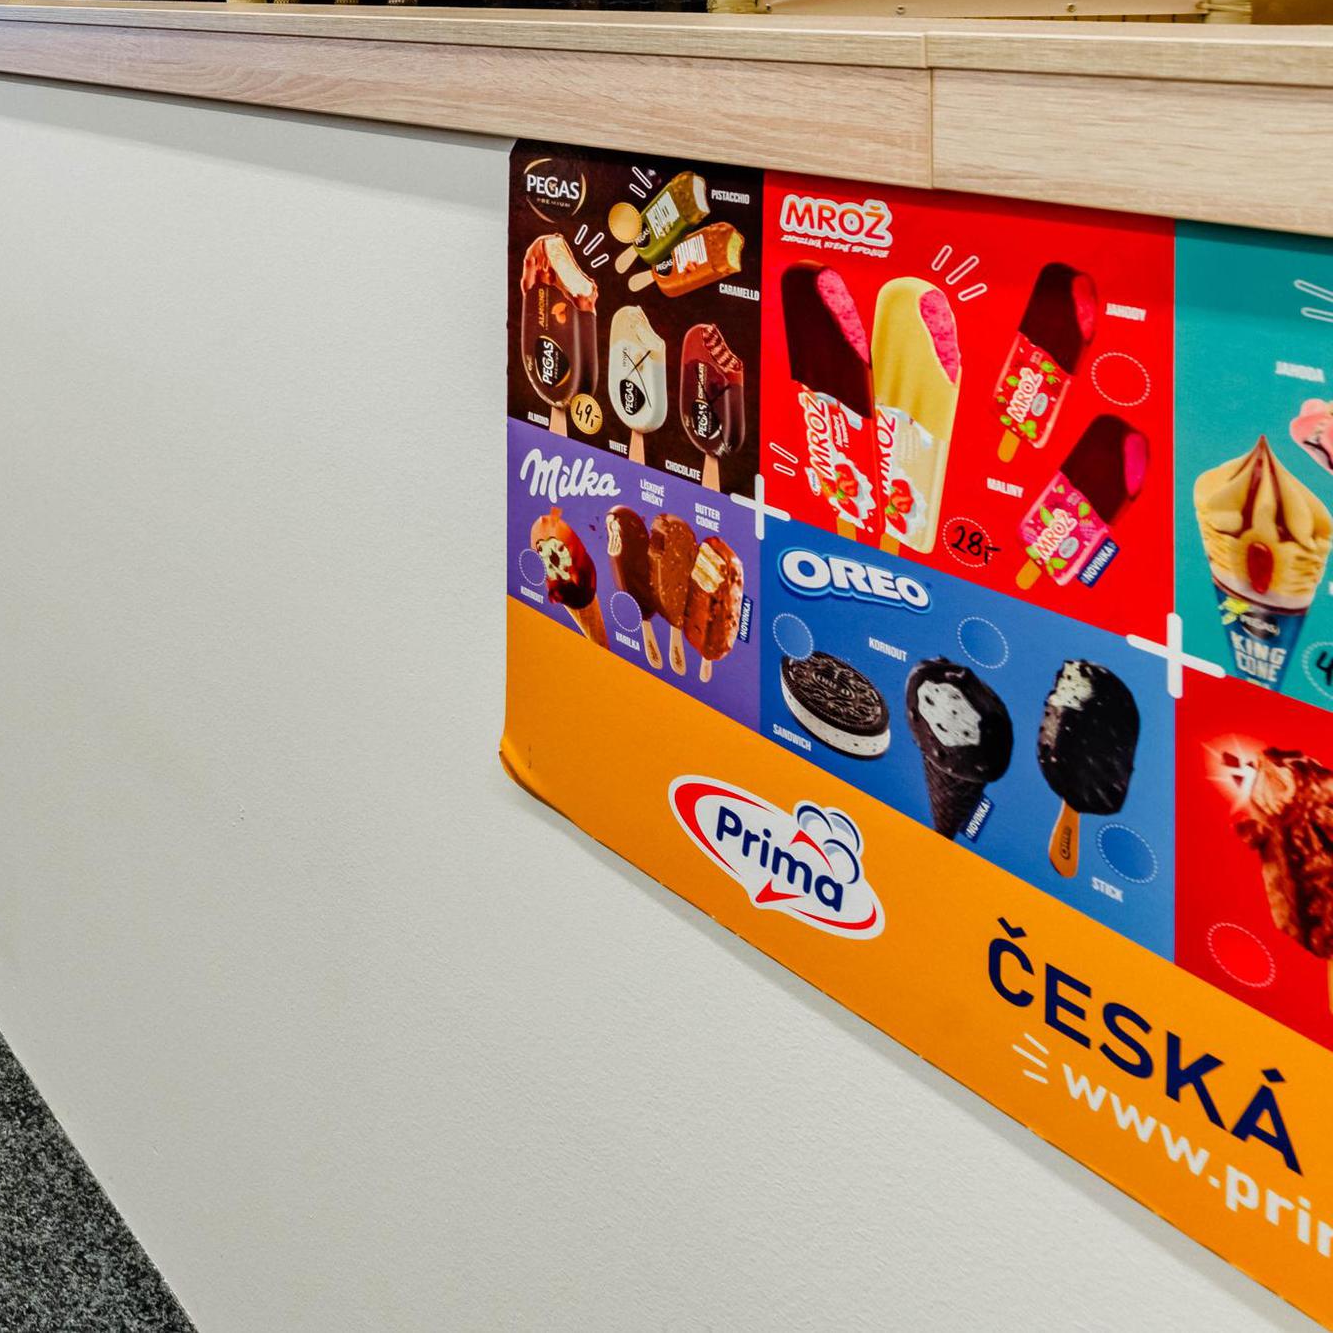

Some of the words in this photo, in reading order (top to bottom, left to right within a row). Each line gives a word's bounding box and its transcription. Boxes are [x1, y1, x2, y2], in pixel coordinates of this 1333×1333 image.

[526, 174, 580, 200] PEGAS
[711, 188, 751, 205] PISTACCHIO
[781, 195, 891, 245] MROŽ
[718, 283, 760, 302] CARAMELLO
[542, 340, 555, 386] PEGAS
[625, 380, 634, 415] PEGAS
[608, 438, 628, 455] WHITE
[519, 447, 622, 504] Milka
[665, 459, 702, 482] CHOCOLATE
[694, 502, 721, 522] BUTTER
[695, 514, 721, 533] COOKIE
[781, 550, 930, 609] OREO
[868, 636, 908, 663] KORNOUT
[1230, 630, 1288, 666] KING
[1235, 649, 1283, 683] CONE
[772, 722, 813, 753] SANDWICH
[715, 805, 844, 913] Prima
[1091, 876, 1124, 903] STICK
[988, 916, 1304, 1177] ČESKÁ
